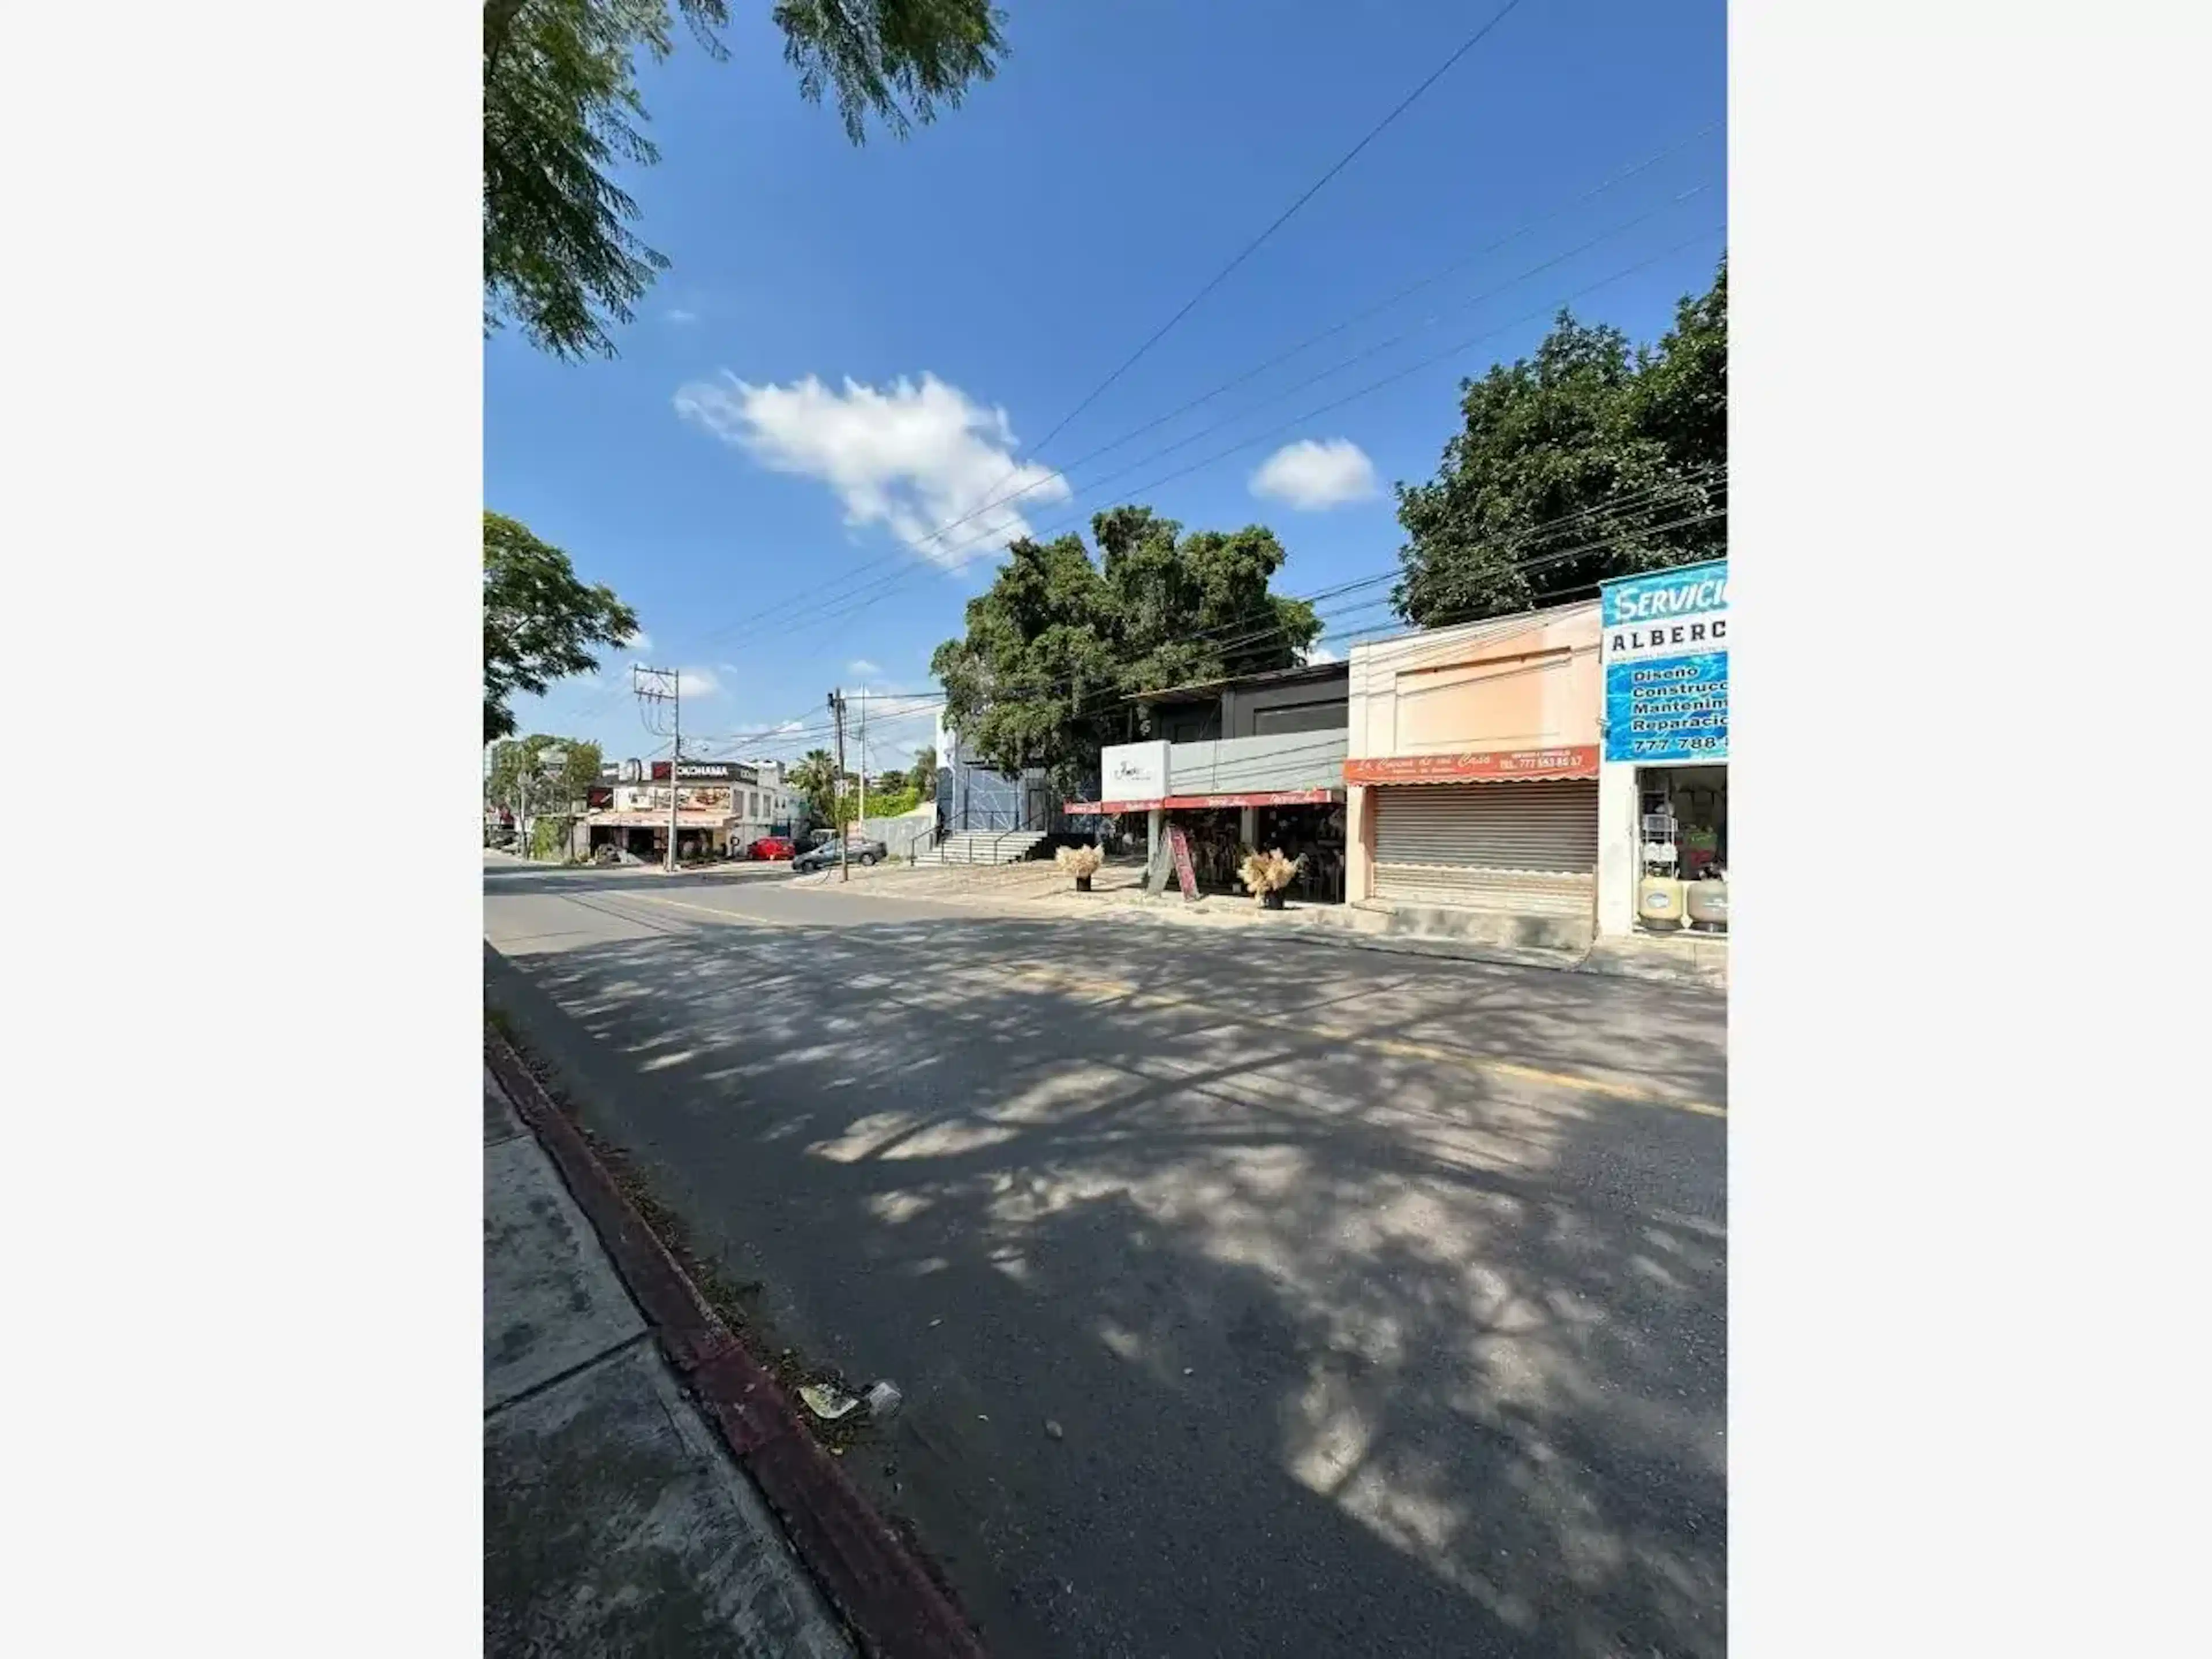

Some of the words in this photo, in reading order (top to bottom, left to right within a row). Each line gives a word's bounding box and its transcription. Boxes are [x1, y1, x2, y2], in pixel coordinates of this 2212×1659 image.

[1615, 579, 1727, 618] SERVICI
[1635, 740, 1668, 751] 777
[676, 766, 729, 775] OKOHAMA
